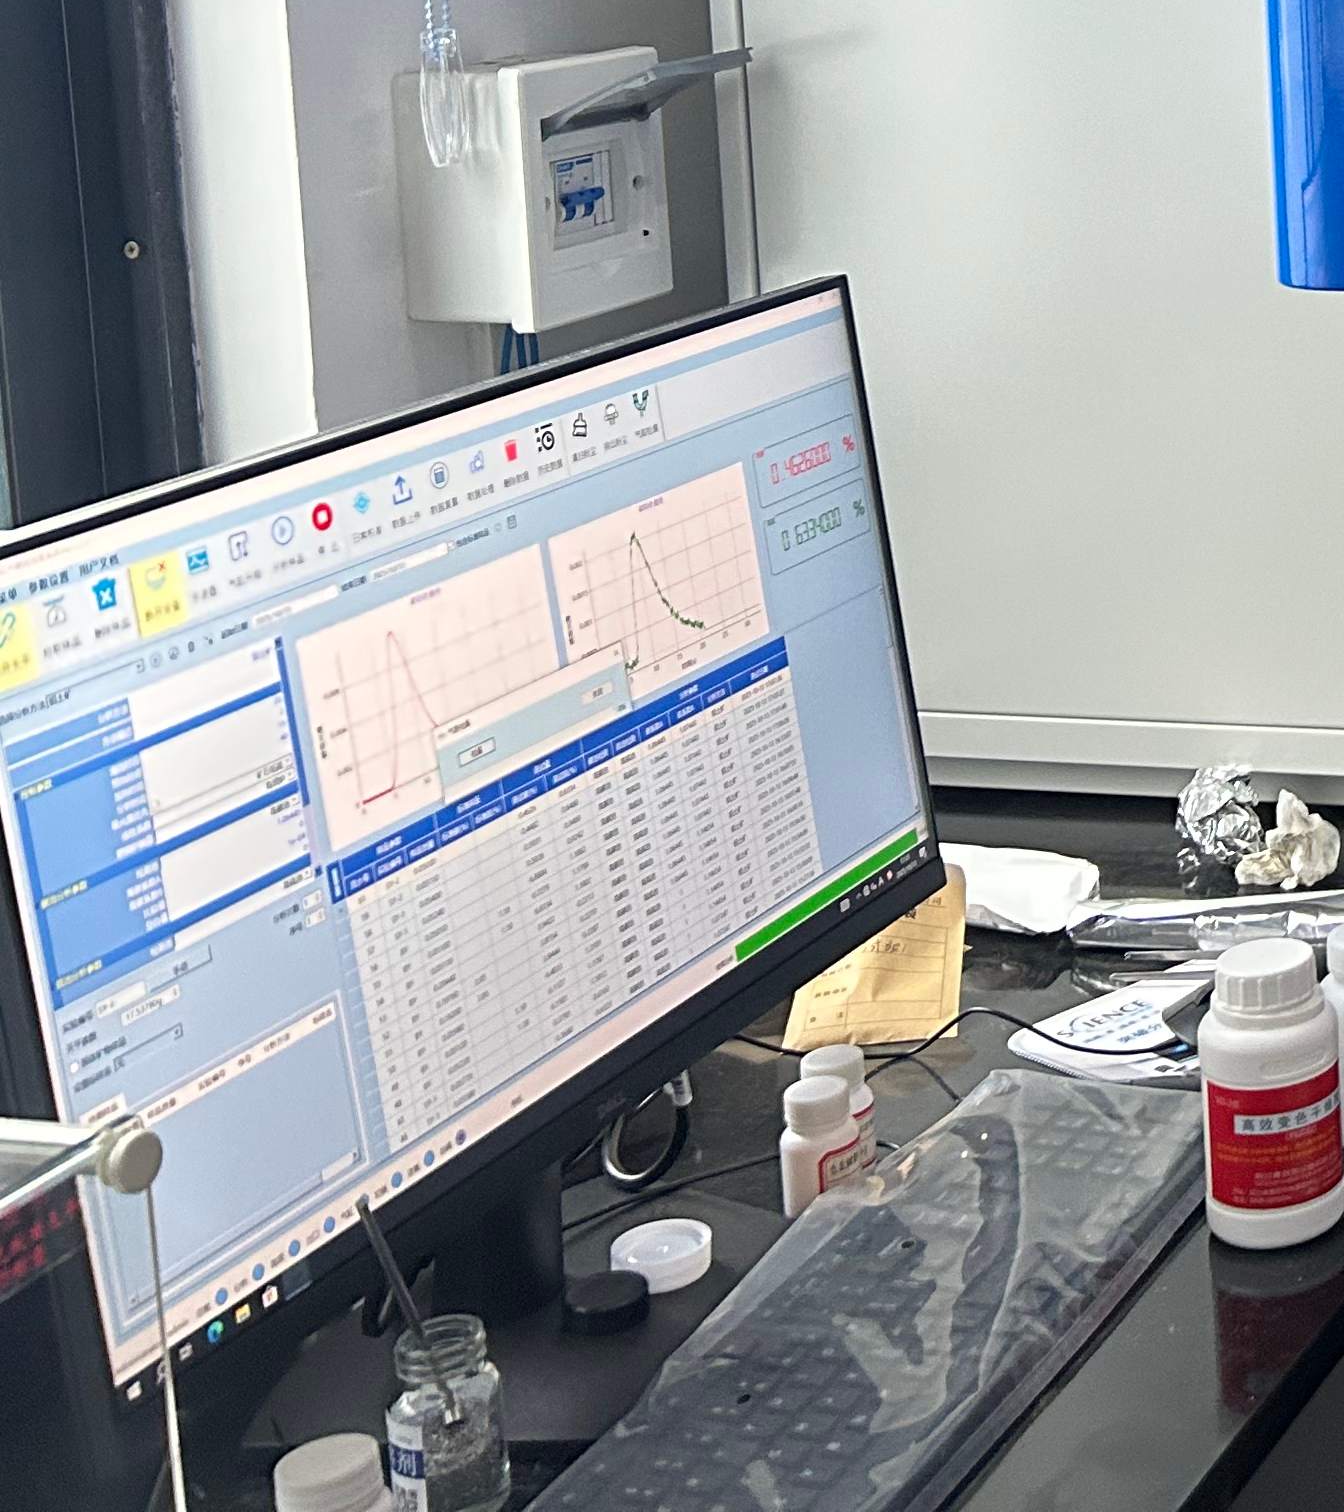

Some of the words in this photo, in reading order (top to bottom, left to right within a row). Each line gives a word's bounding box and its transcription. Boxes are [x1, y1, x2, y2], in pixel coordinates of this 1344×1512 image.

[78, 553, 119, 577] 用户文档
[1056, 999, 1149, 1038] SCIENCE
